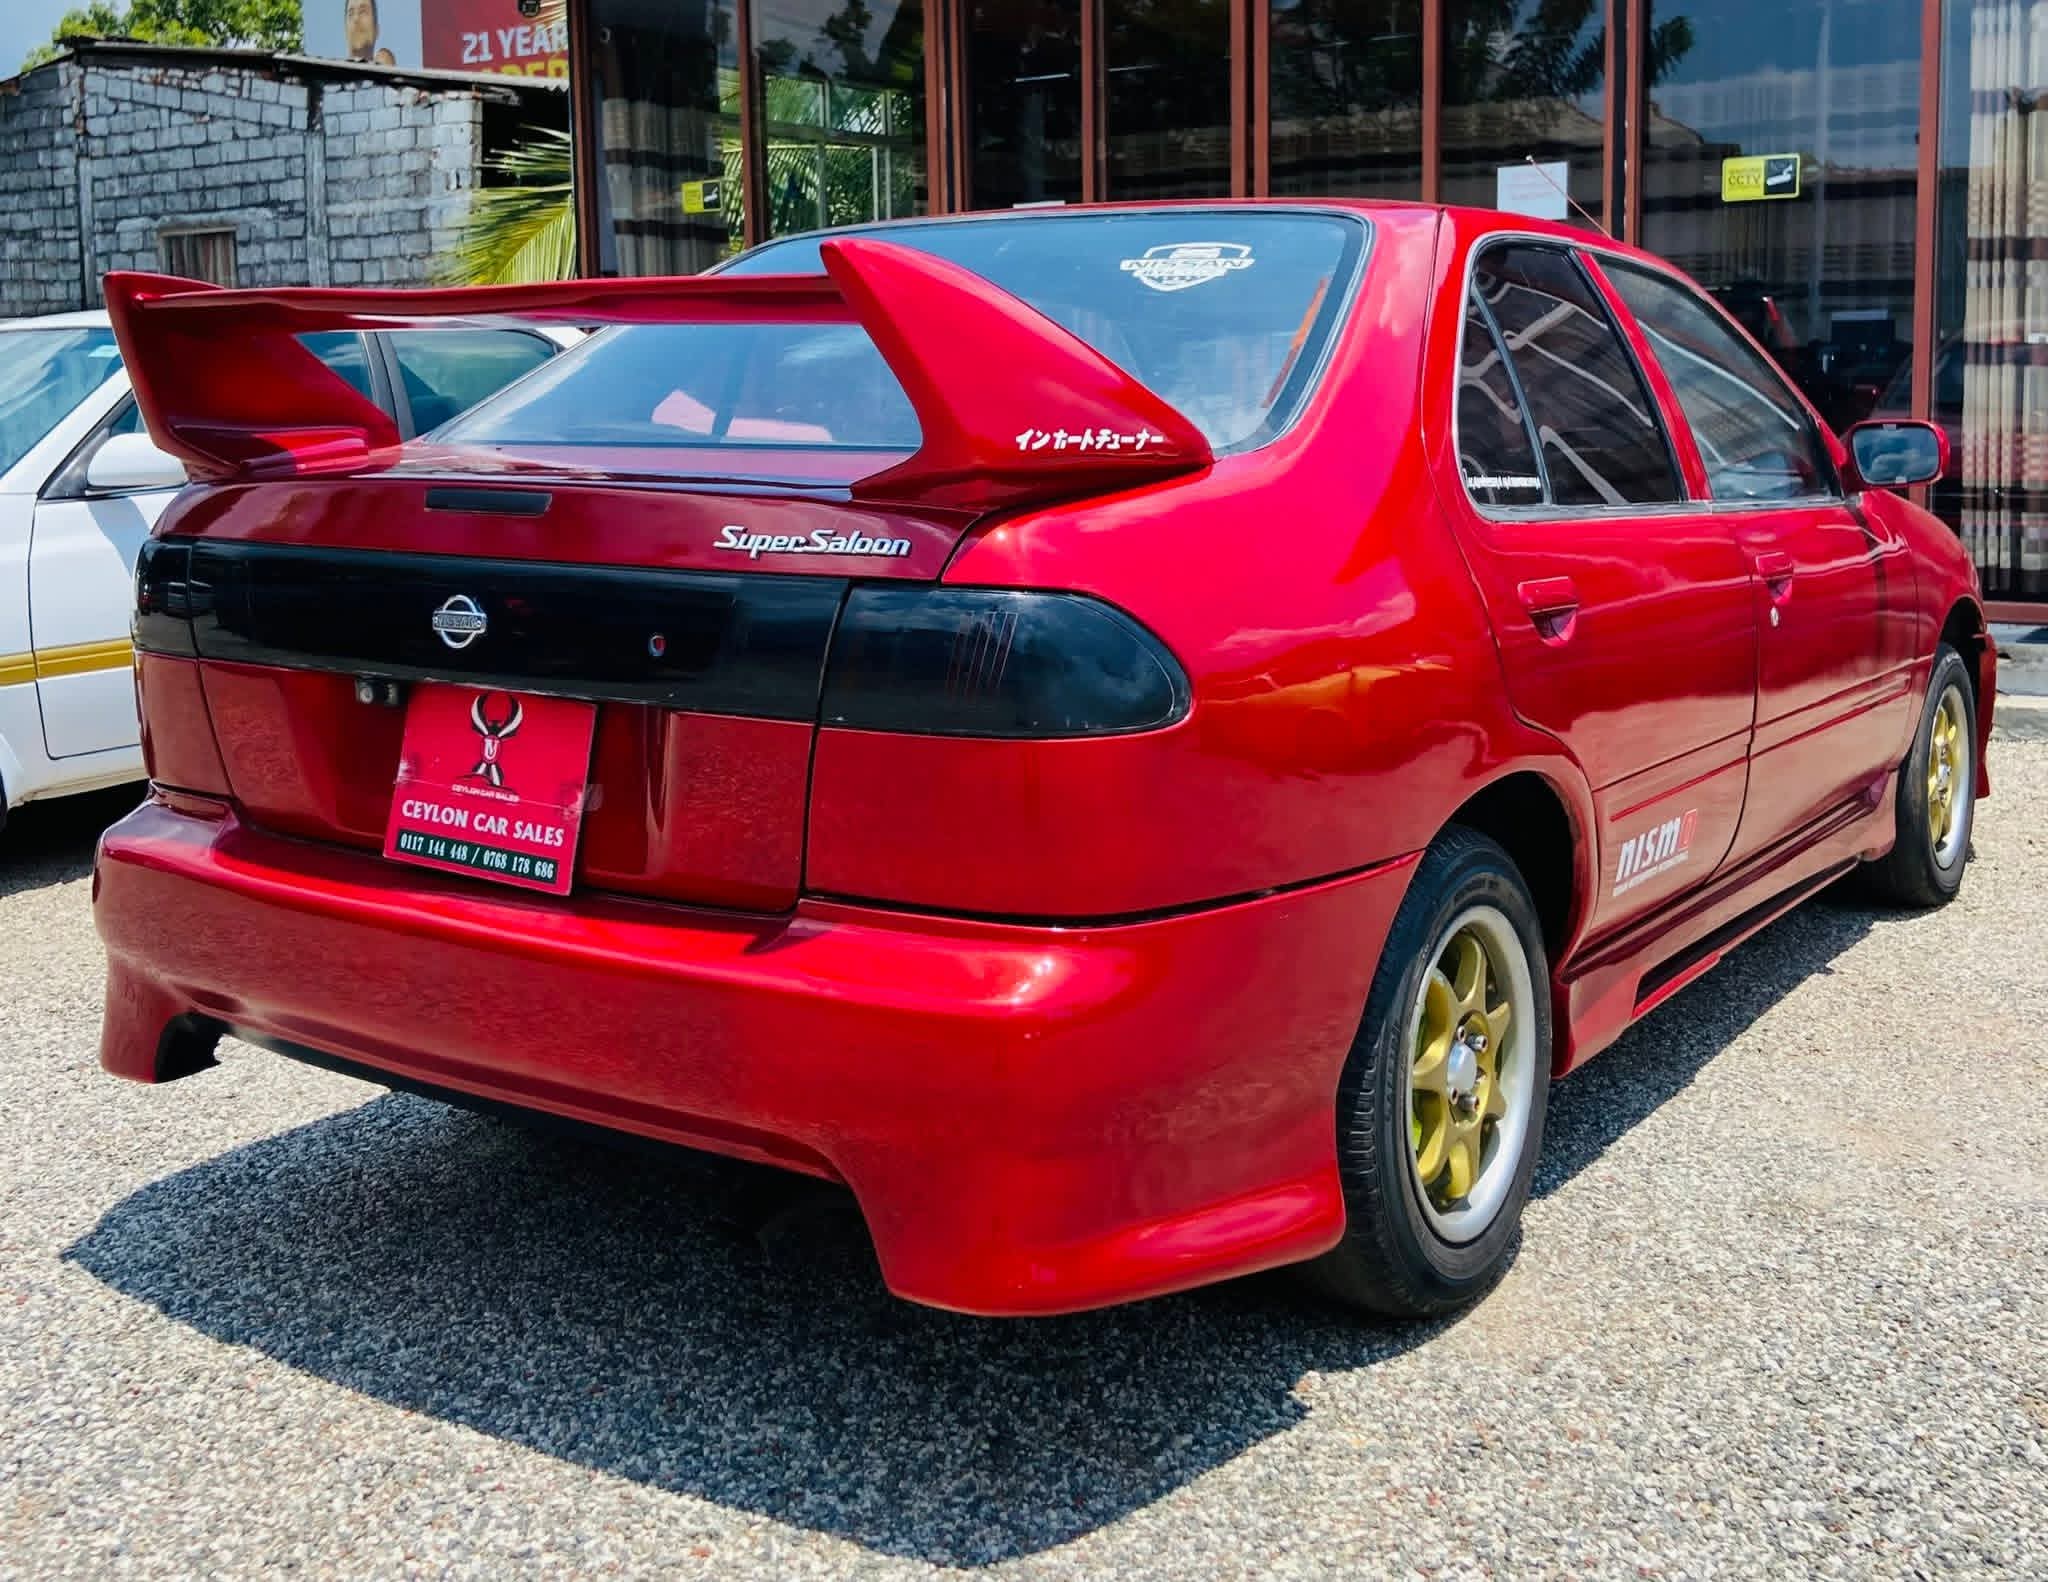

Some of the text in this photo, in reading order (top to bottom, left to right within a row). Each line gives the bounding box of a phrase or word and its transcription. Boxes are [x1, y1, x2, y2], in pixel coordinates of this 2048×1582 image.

[463, 32, 493, 64] 21
[1728, 174, 1761, 186] CCTV
[402, 799, 565, 847] CEYLON CAR SALES
[400, 833, 424, 850] 0117
[429, 839, 446, 857] 144
[450, 843, 468, 862] 448
[483, 849, 507, 869] 0768
[512, 857, 530, 874] 178
[534, 861, 554, 879] 686
